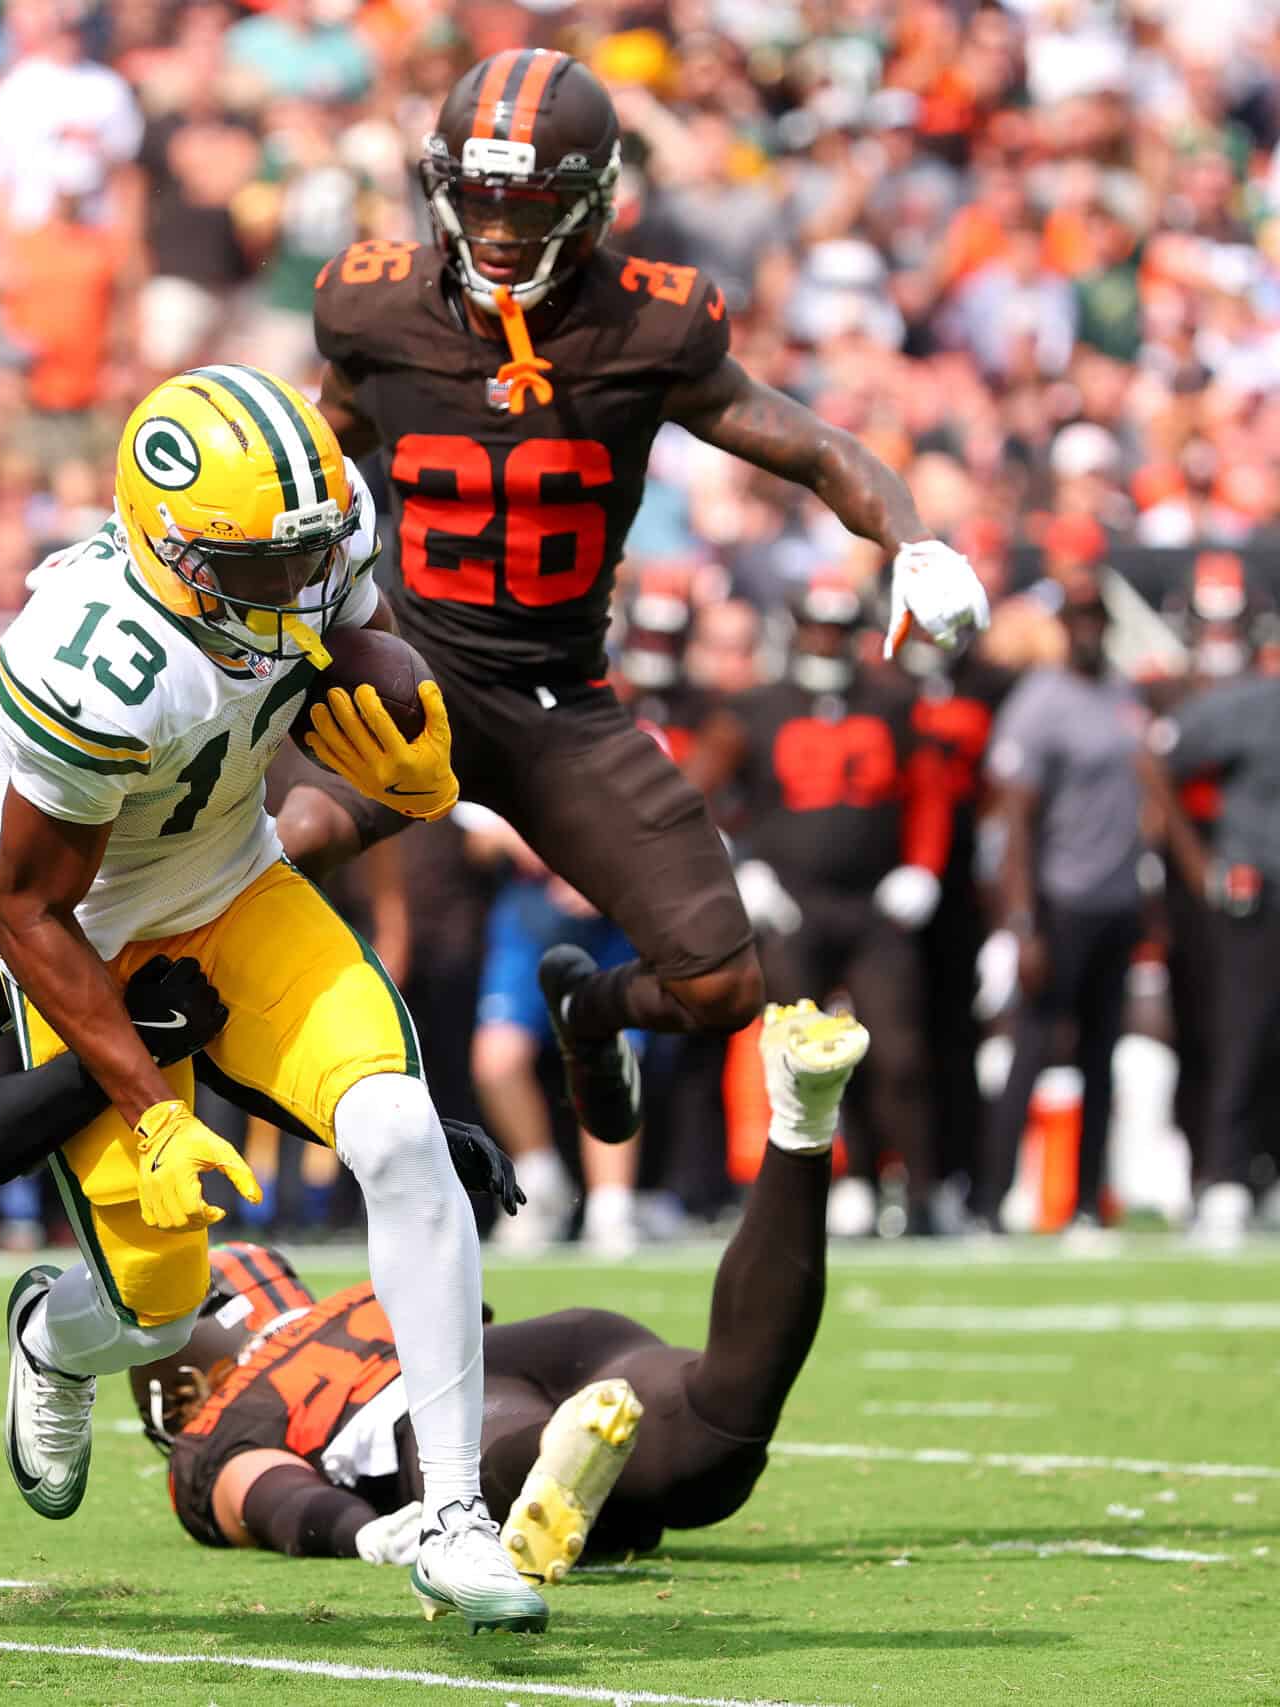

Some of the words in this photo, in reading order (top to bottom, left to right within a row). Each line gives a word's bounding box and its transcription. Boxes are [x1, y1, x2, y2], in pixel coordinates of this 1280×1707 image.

[134, 418, 200, 489] G
[392, 433, 614, 607] 26
[53, 601, 167, 706] 13
